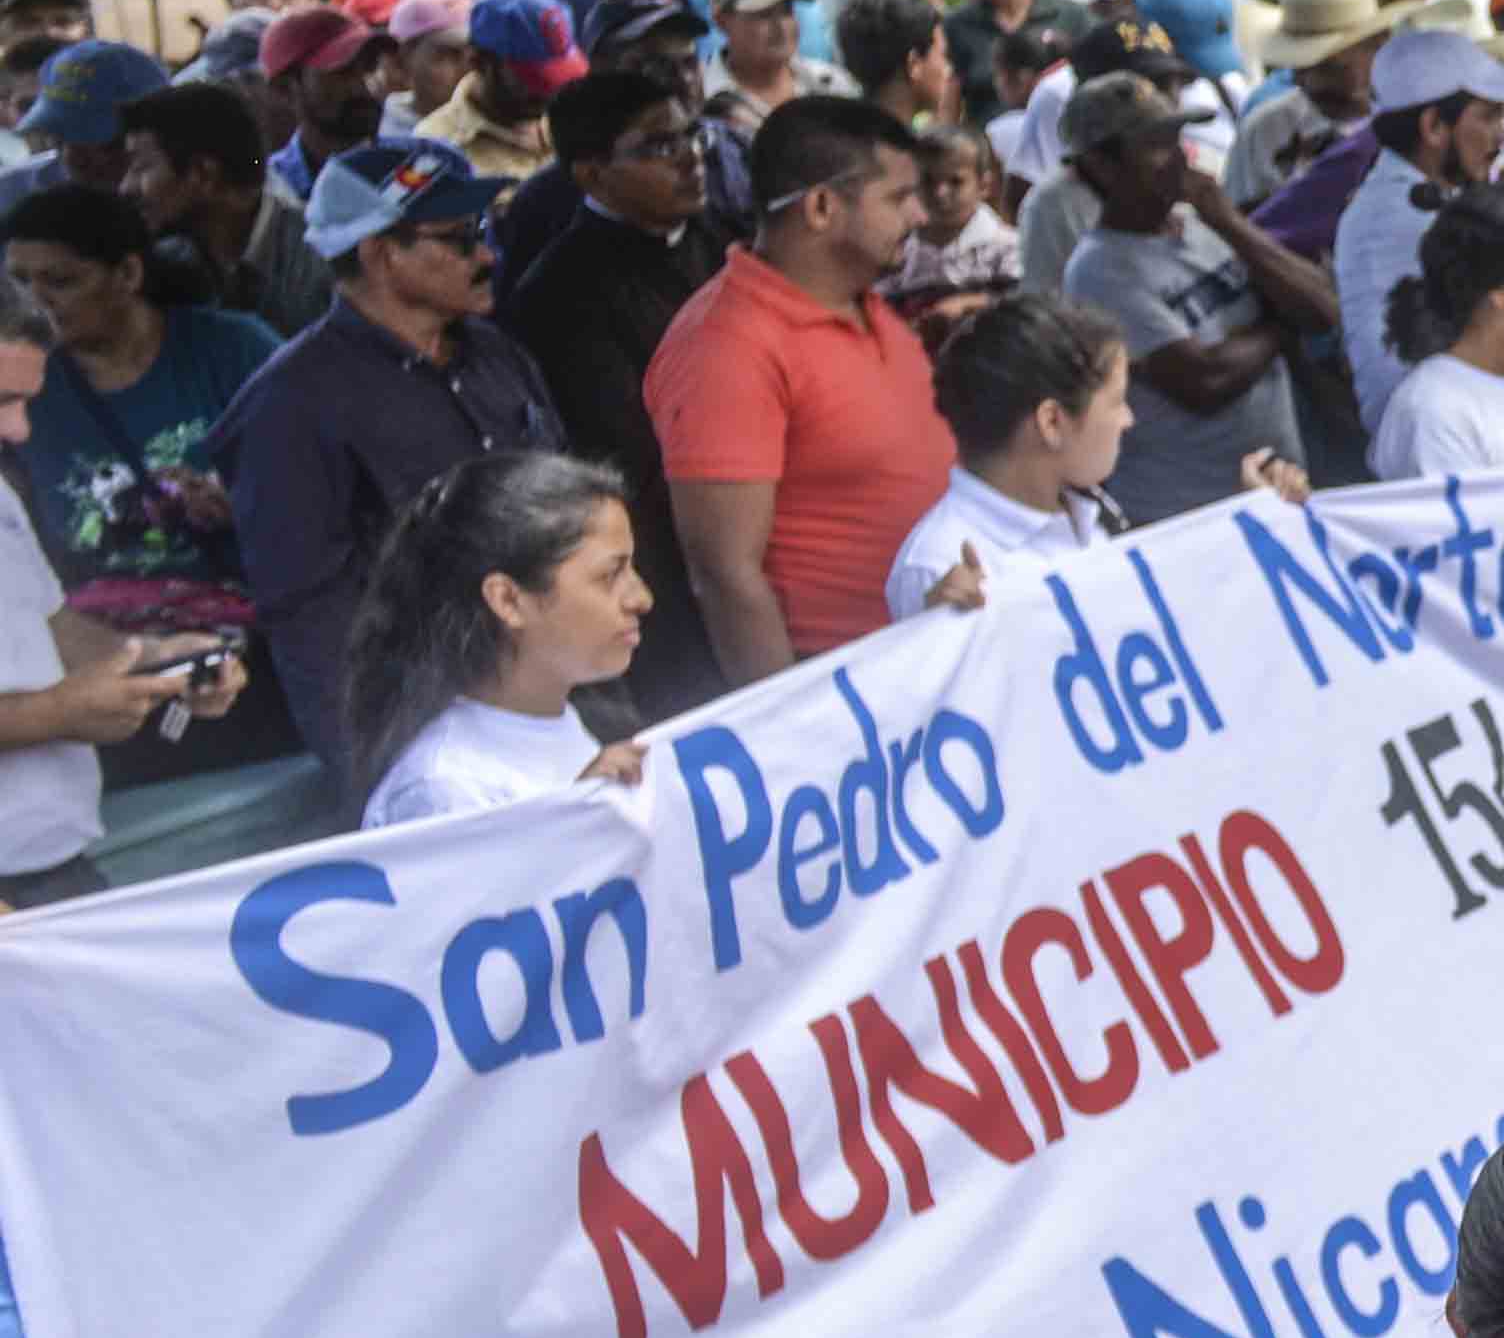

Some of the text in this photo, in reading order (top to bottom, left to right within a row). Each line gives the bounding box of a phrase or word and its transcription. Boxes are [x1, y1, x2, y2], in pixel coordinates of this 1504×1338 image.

[229, 861, 648, 1138] San
[676, 665, 1001, 971] Pedro
[1053, 545, 1225, 774] del
